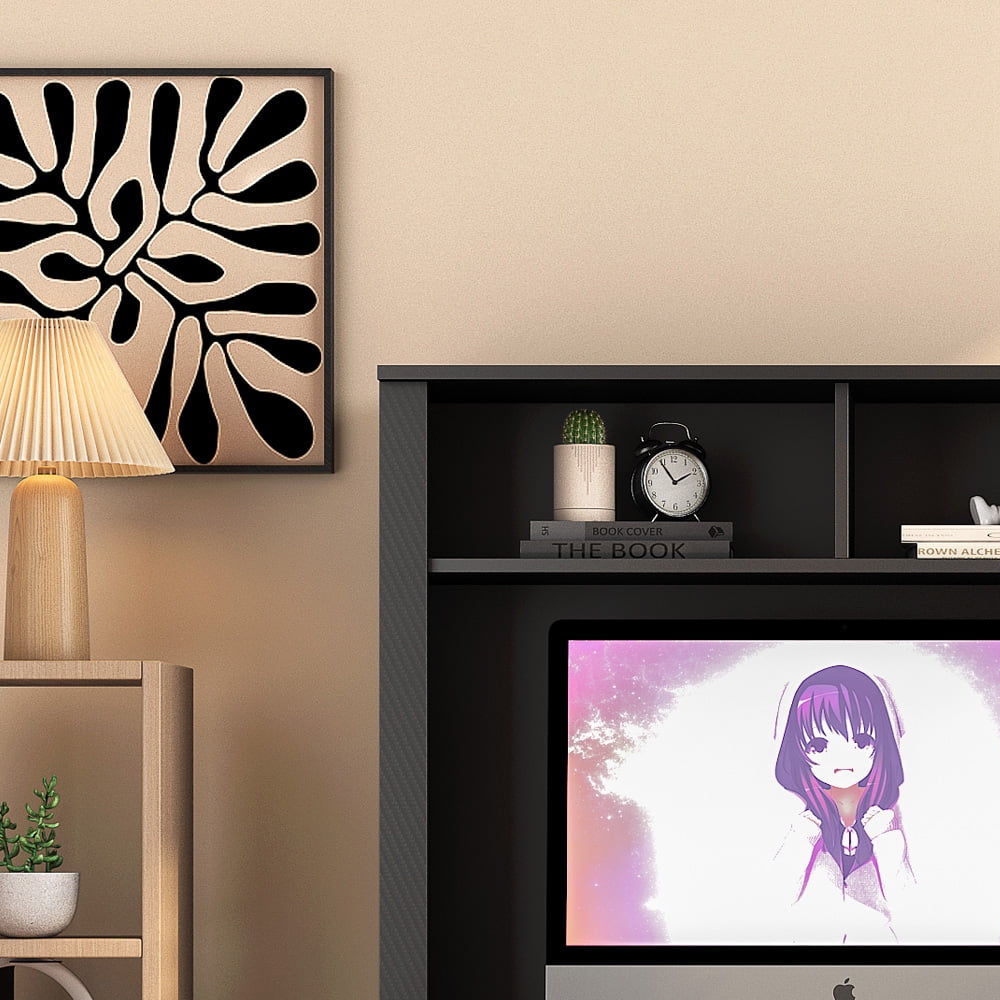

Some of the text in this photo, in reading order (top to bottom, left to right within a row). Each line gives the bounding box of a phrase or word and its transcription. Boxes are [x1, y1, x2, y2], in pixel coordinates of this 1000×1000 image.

[670, 455, 678, 463] 12
[592, 527, 663, 536] BOOK COVER
[552, 543, 686, 559] THE BOOK
[918, 548, 958, 556] ROWN
